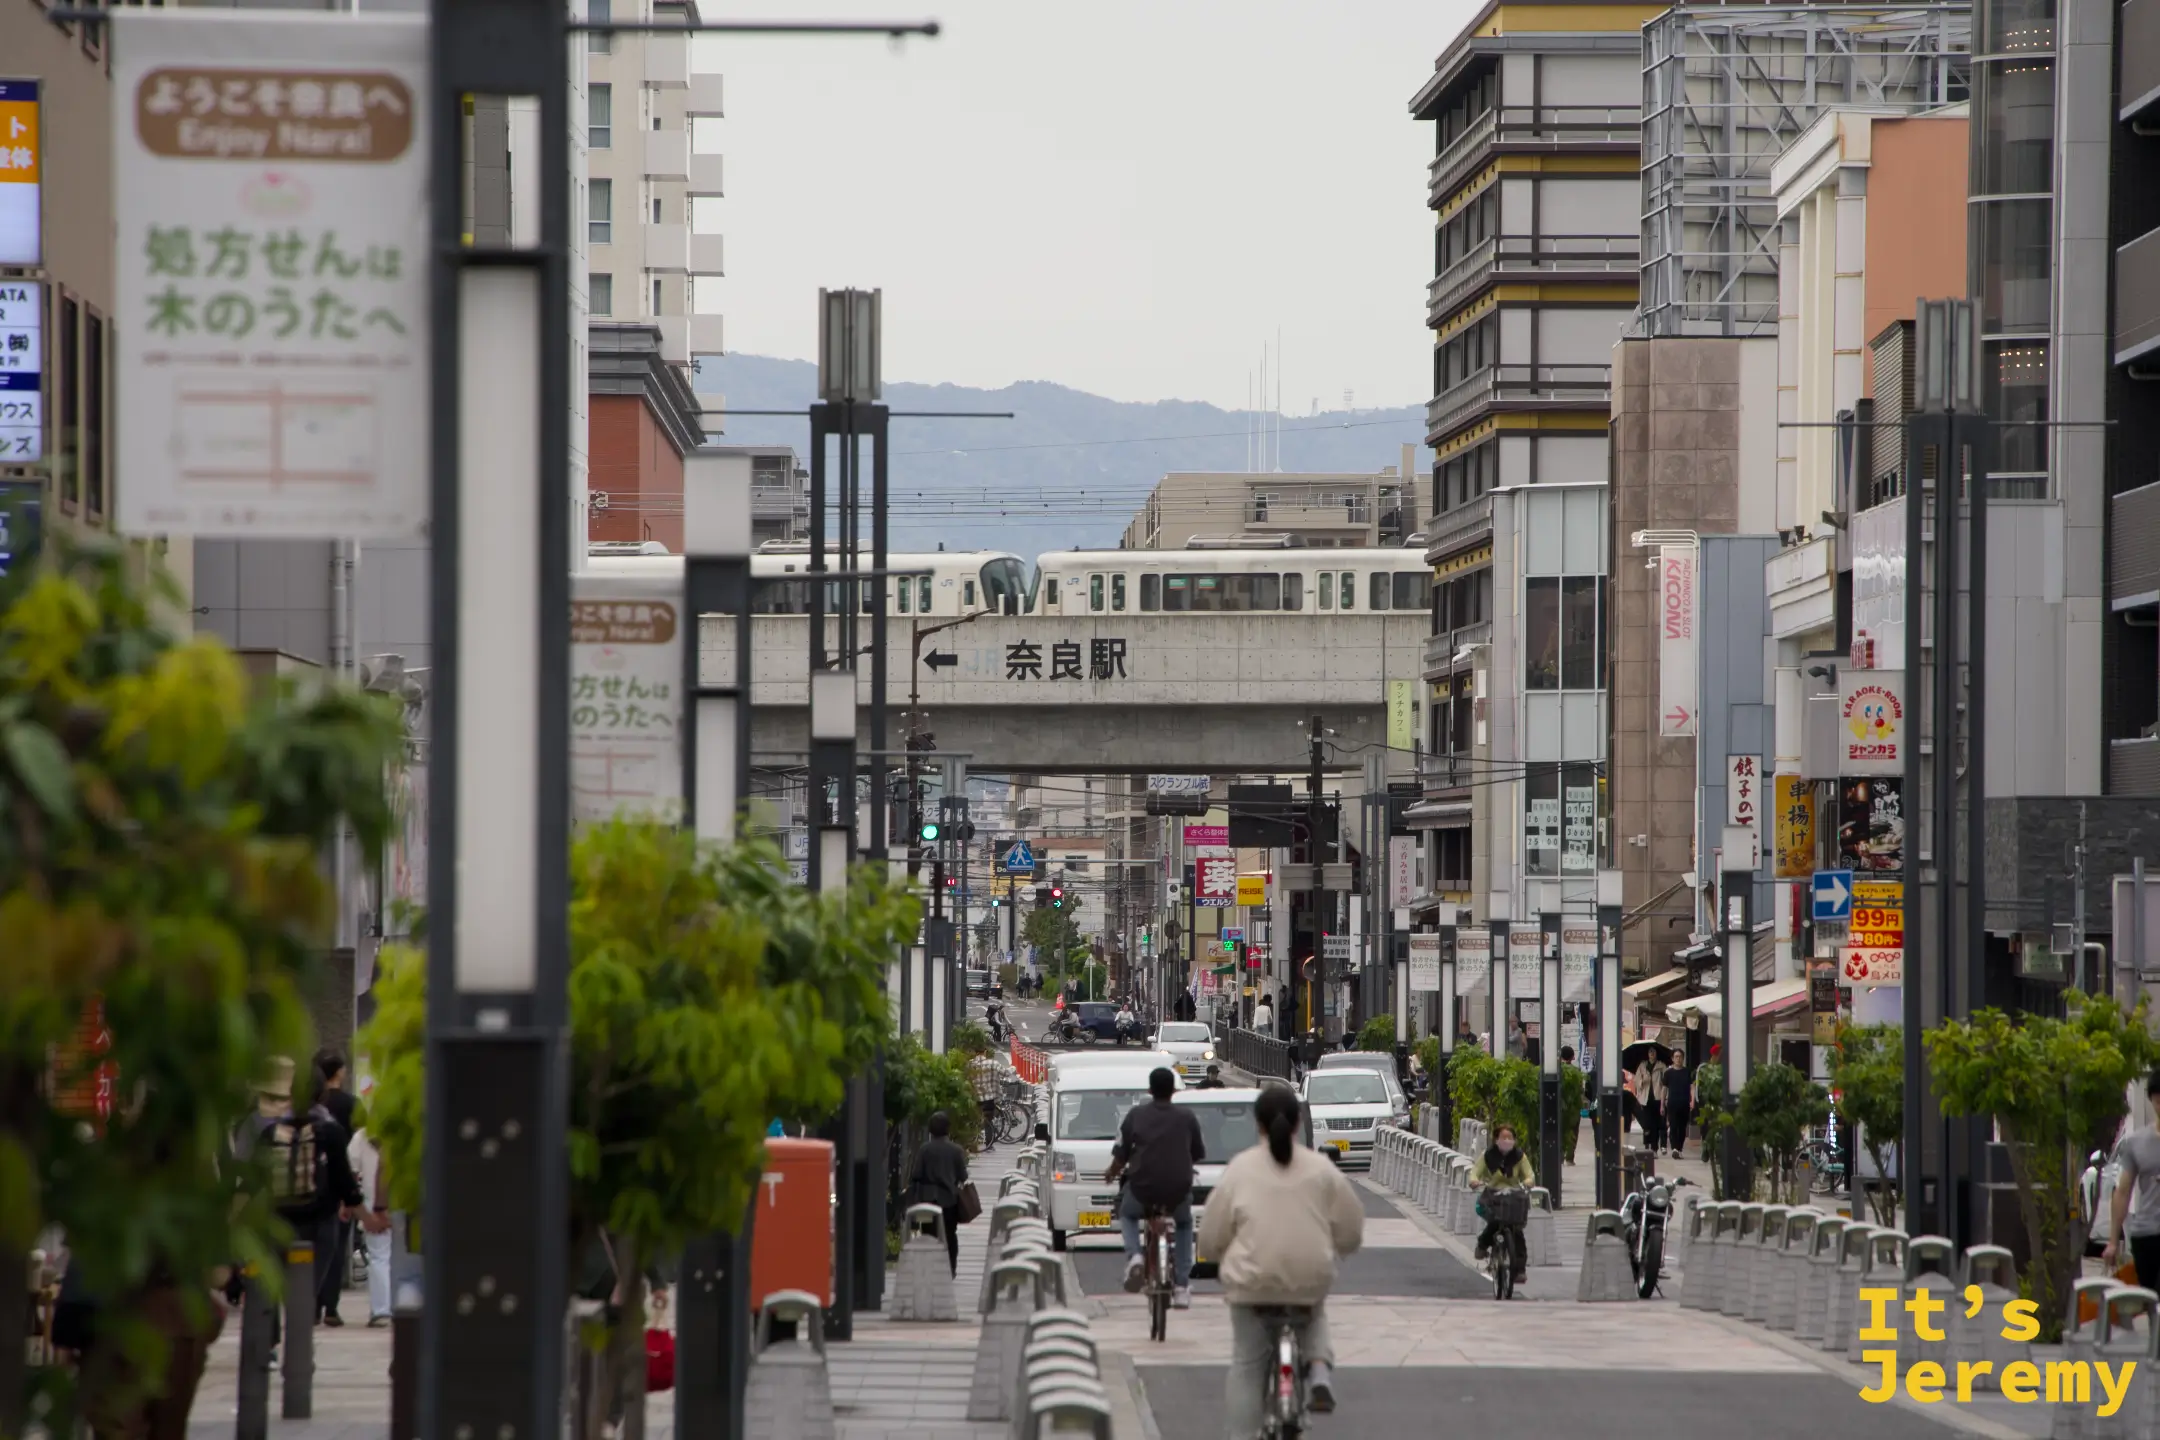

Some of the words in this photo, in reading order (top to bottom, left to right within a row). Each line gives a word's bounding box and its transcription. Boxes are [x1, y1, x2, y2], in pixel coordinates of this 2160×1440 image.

[144, 283, 408, 340] 木のうたへ
[1665, 558, 1681, 639] KICONA
[1683, 617, 1692, 640] SLOT
[1005, 638, 1128, 681] 奈良駅
[1396, 682, 1405, 732] ランチカフェ
[1849, 744, 1897, 754] ジャンカラ
[1203, 860, 1236, 896] 薬
[1227, 929, 1242, 939] P
